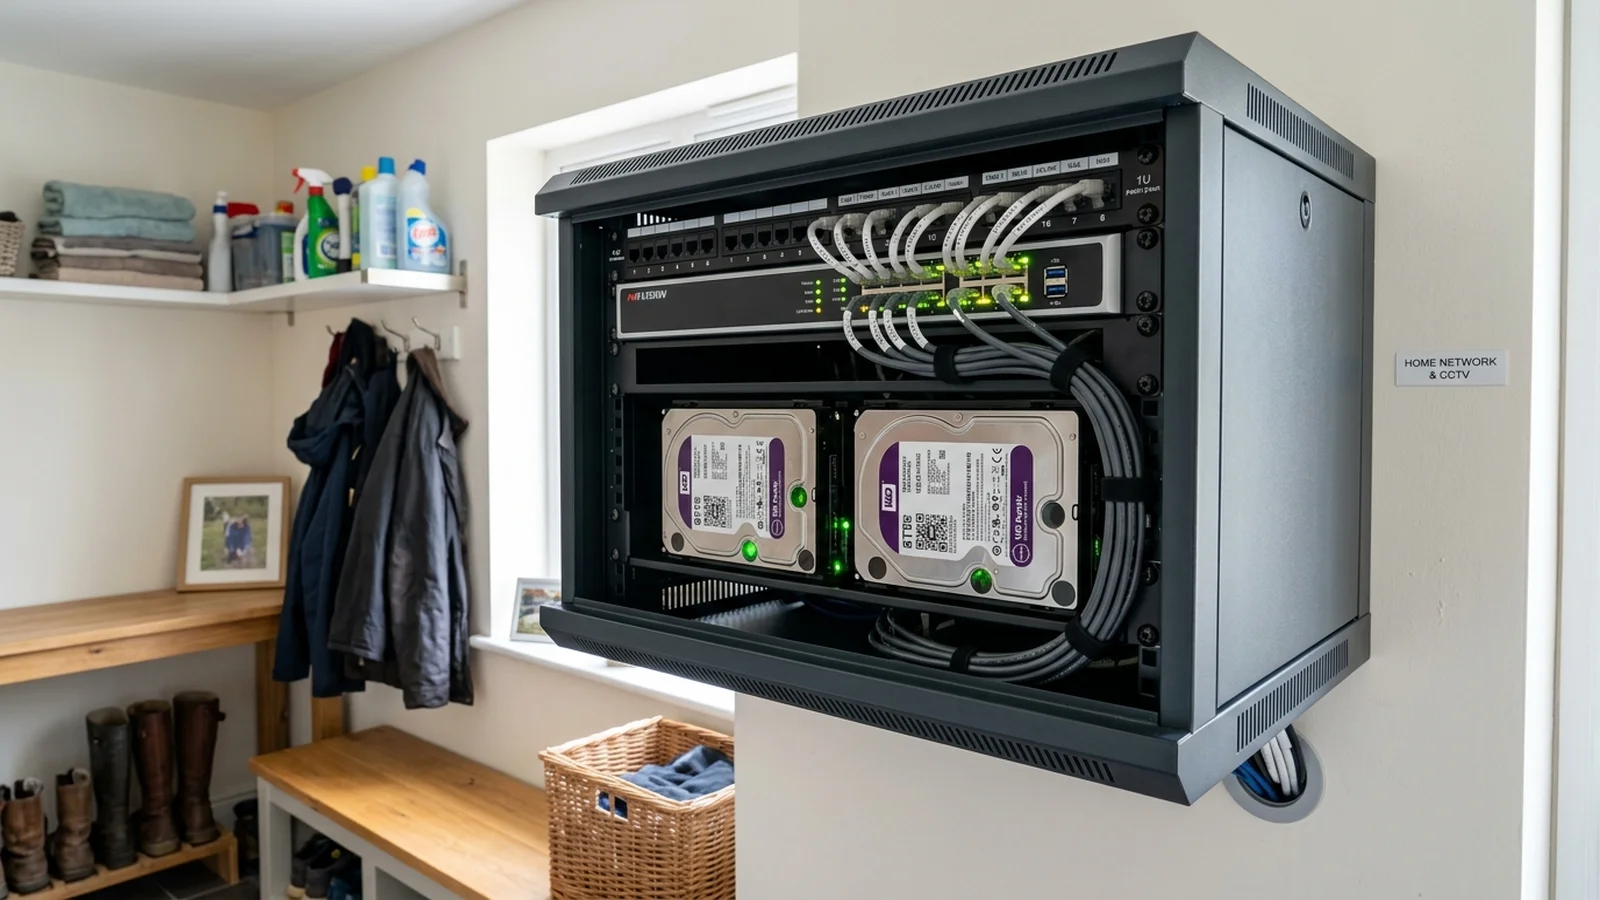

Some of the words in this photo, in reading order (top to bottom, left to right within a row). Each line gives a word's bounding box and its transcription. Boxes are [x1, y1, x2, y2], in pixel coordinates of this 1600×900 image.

[1136, 174, 1151, 185] 1U
[1404, 358, 1437, 367] HOME
[1439, 357, 1498, 367] NETWORK
[1429, 371, 1437, 380] &
[1439, 370, 1471, 380] CCTV
